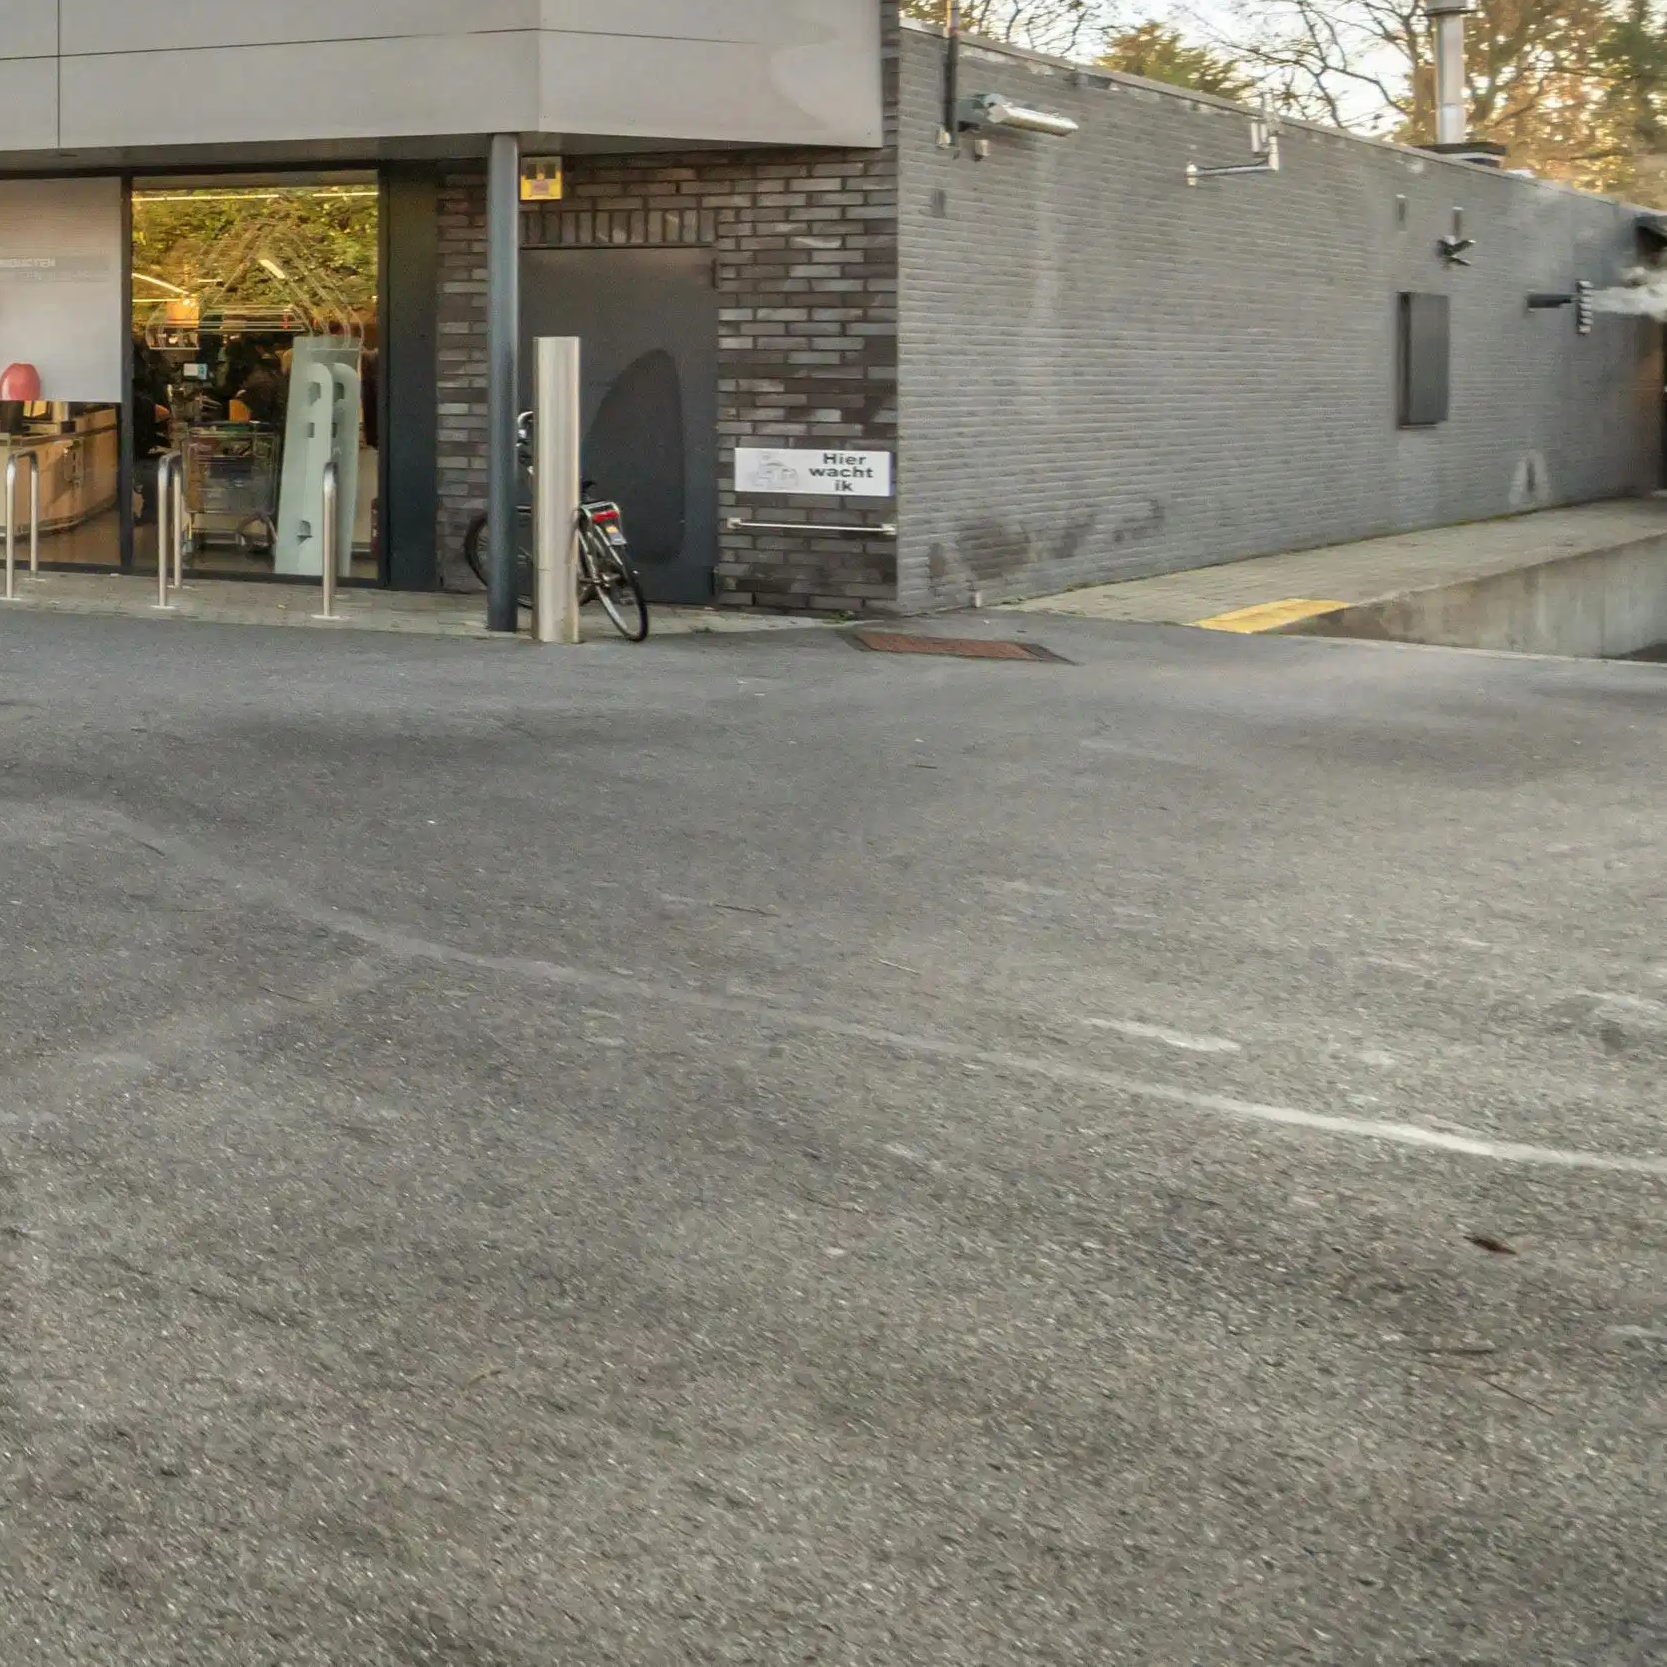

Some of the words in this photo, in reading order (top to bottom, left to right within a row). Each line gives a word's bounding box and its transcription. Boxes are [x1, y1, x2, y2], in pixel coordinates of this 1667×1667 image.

[822, 452, 867, 465] Hier
[808, 465, 874, 478] wacht
[833, 479, 854, 492] ik
